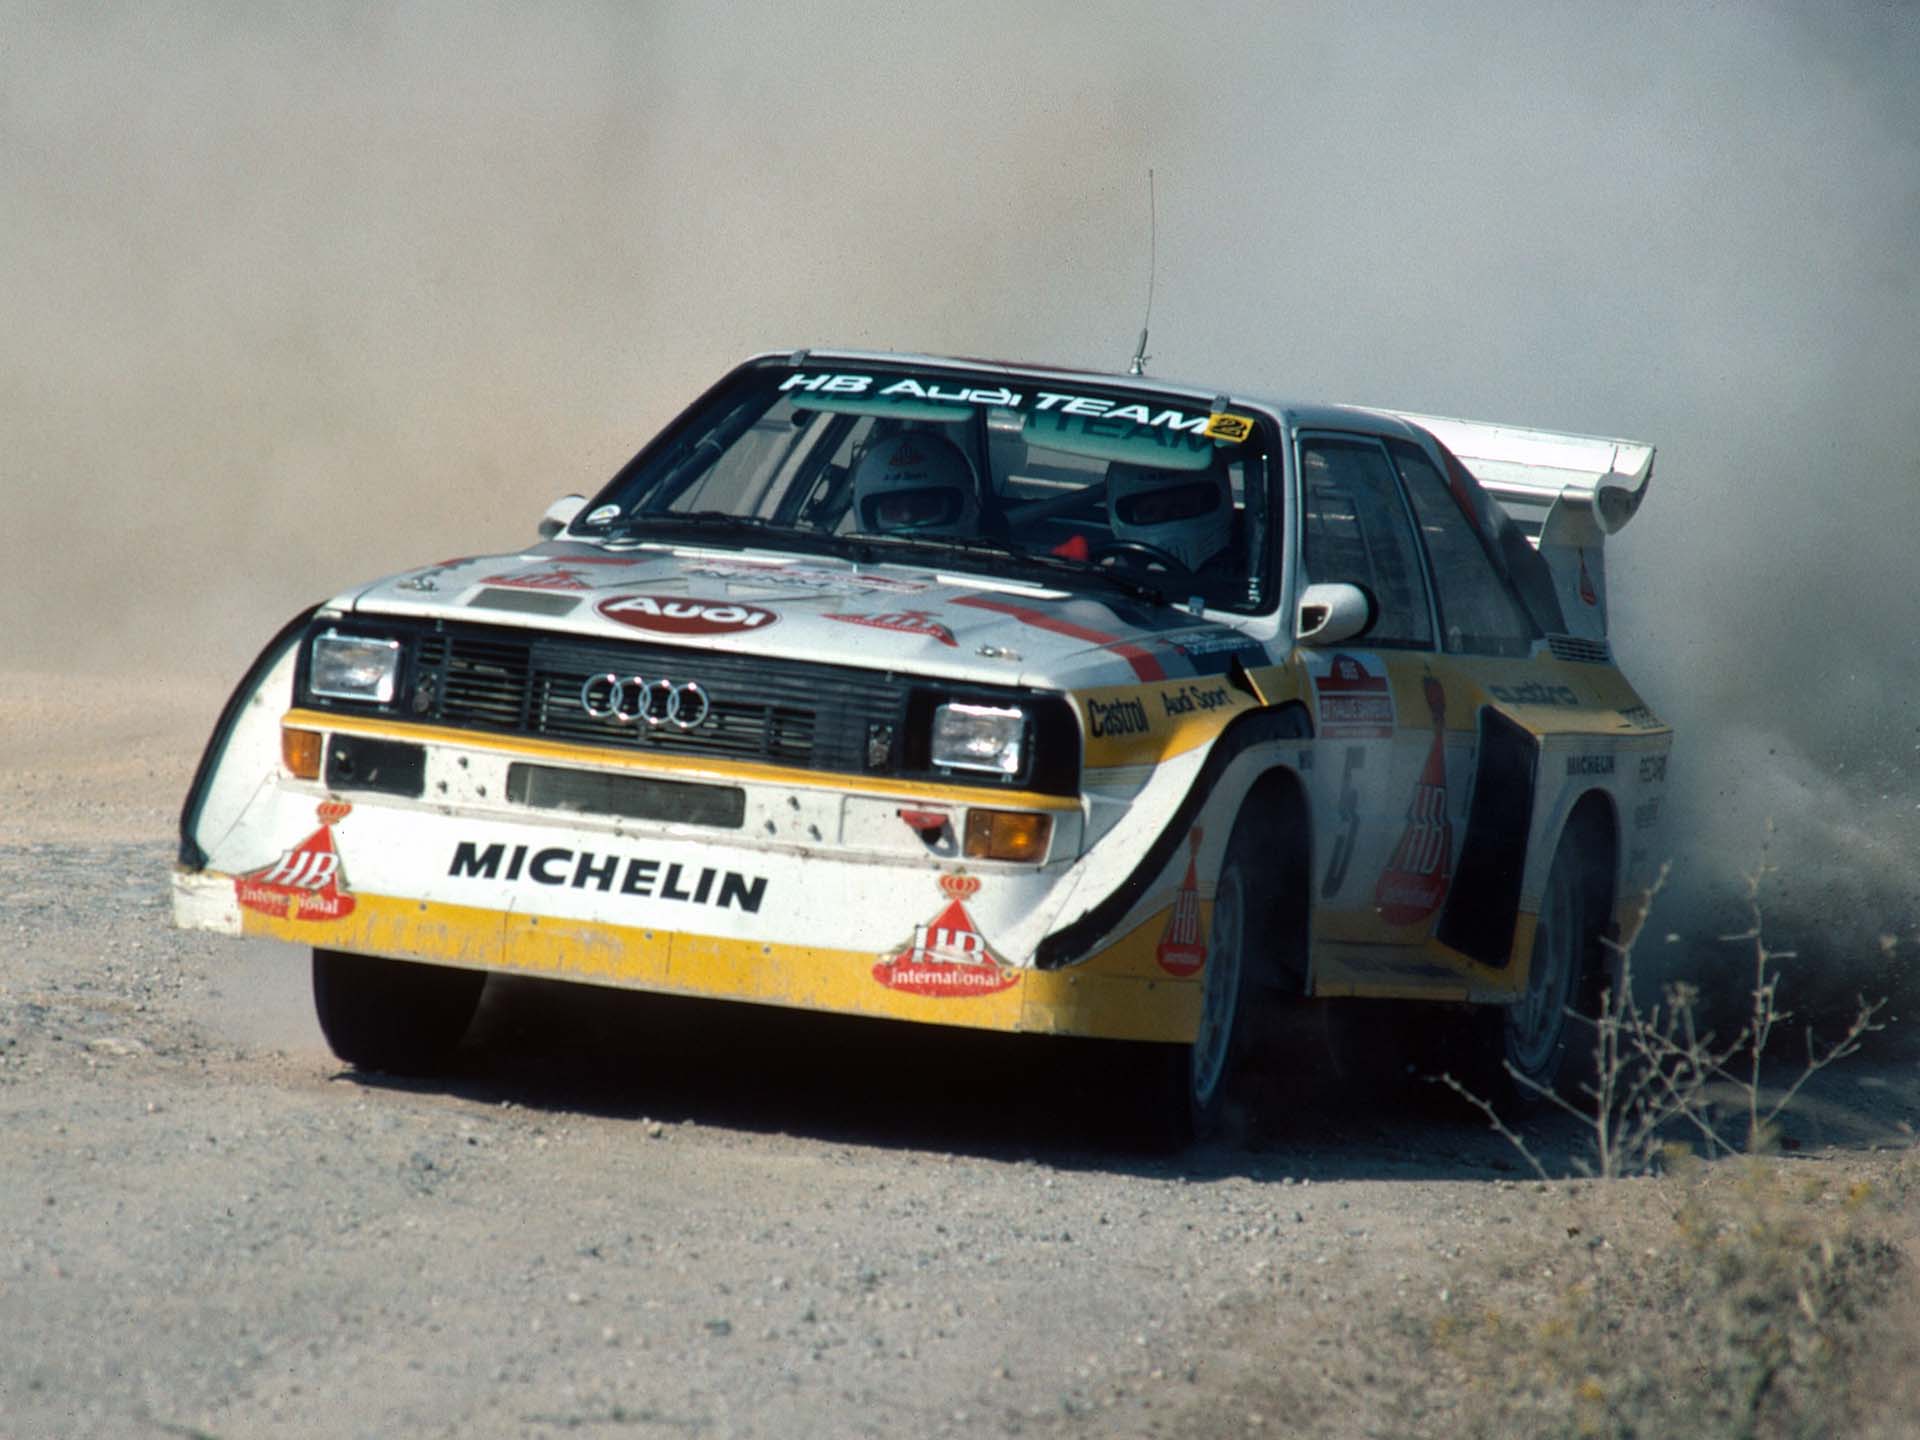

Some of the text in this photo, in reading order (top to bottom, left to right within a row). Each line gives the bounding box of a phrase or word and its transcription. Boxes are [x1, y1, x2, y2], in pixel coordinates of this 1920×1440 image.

[778, 373, 873, 392] HB
[1034, 392, 1209, 434] TEAM
[1087, 696, 1149, 737] Castrol
[1190, 685, 1234, 712] Sport
[263, 850, 340, 890] HB
[448, 841, 768, 914] MICHELIN
[911, 925, 985, 964] HB
